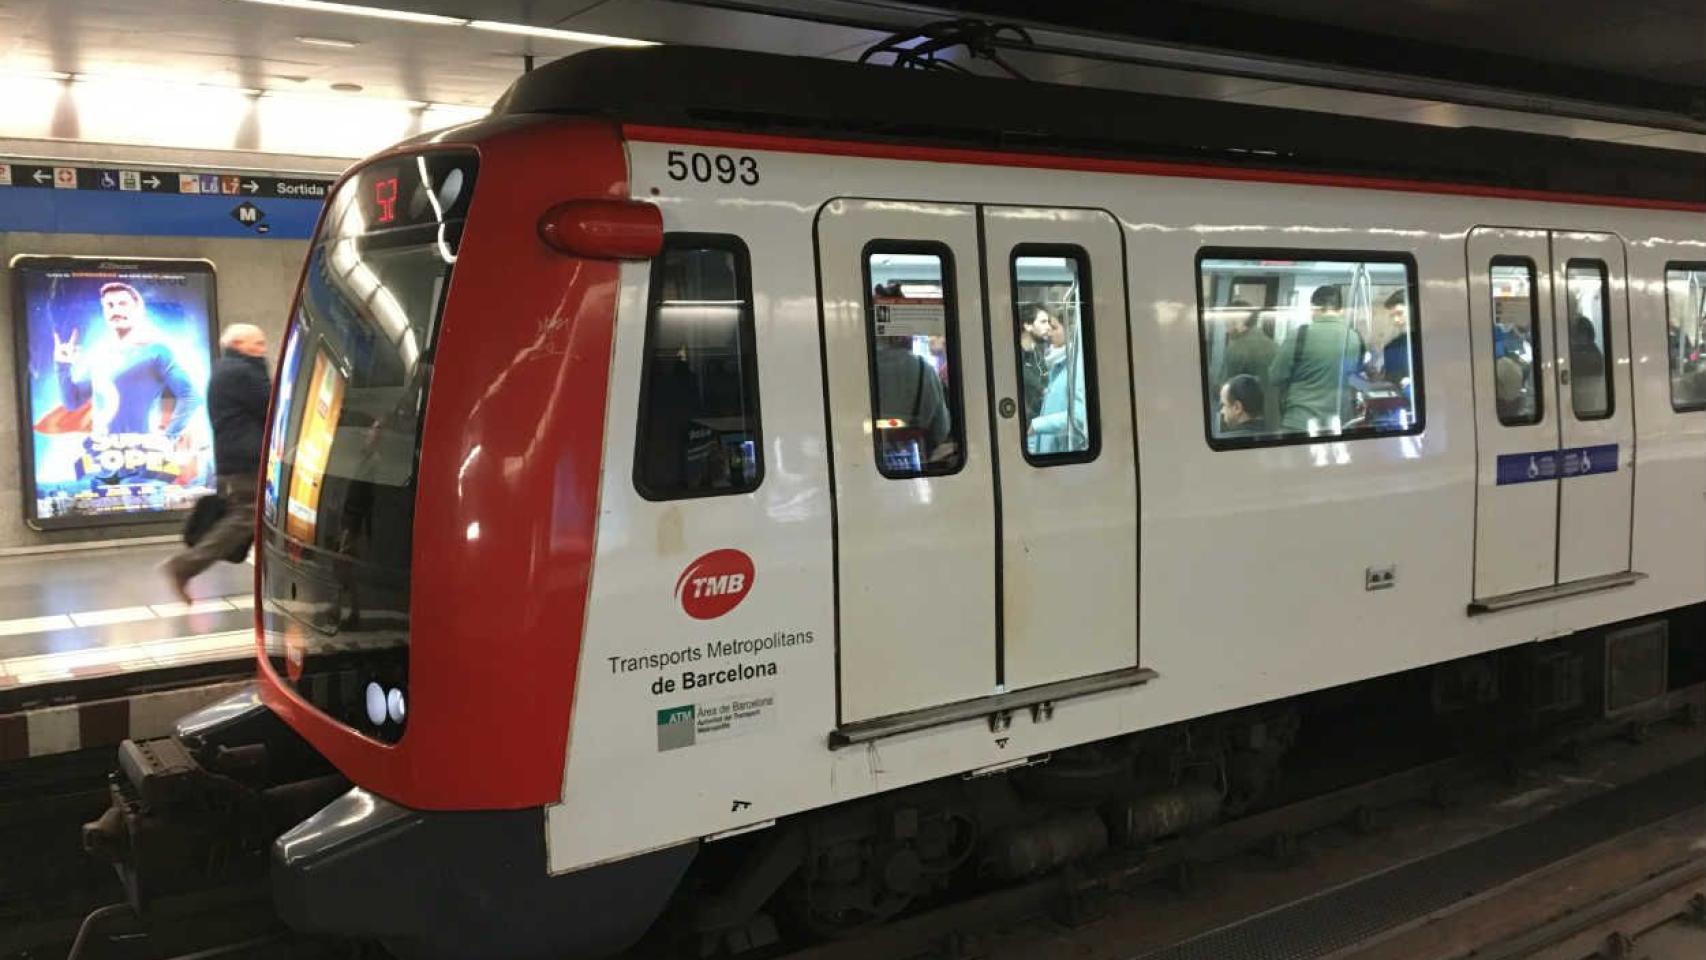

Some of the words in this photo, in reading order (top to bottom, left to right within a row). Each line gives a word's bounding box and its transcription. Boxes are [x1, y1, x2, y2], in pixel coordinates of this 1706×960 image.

[667, 150, 759, 185] 5093
[222, 178, 239, 194] L7
[277, 182, 324, 196] Sortida
[239, 207, 256, 221] M
[693, 573, 745, 598] TMB
[607, 646, 701, 674] Transports
[707, 630, 814, 658] Metropolitans
[651, 677, 675, 695] de
[682, 661, 777, 690] Barcelona
[669, 710, 693, 724] ATM
